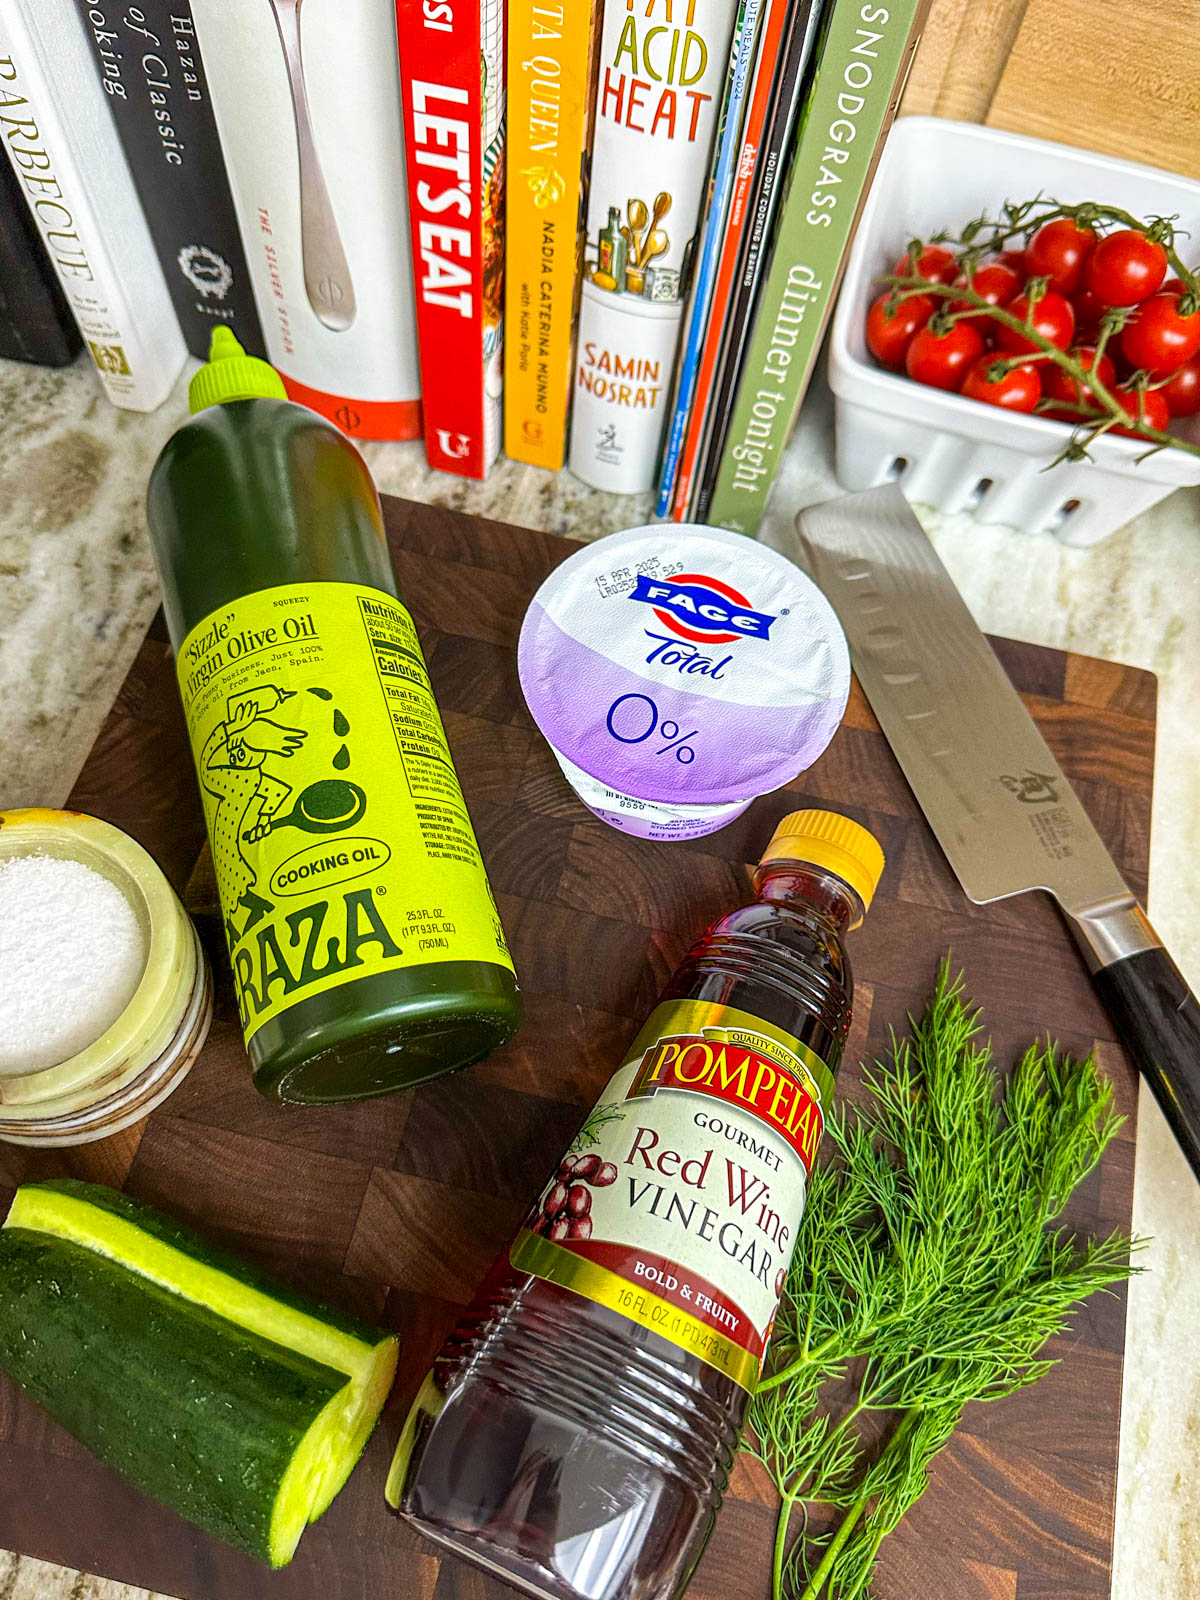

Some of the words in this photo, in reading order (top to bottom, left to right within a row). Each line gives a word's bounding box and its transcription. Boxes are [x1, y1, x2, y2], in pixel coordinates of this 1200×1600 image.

[123, 6, 160, 47] of
[422, 0, 453, 33] SI
[86, 0, 127, 100] oking
[169, 14, 203, 101] Hazan
[613, 15, 708, 87] ACID
[141, 53, 184, 165] Classic
[522, 55, 561, 158] QUEEN
[601, 66, 713, 142] HEAT
[733, 75, 744, 100] 2024
[806, 4, 890, 228] SNODGRASS
[411, 79, 472, 219] LET'S
[739, 143, 757, 179] delish
[762, 152, 777, 196] HOLIDAY
[258, 207, 273, 236] THE
[752, 198, 769, 242] COOKING
[419, 219, 473, 319] EAT
[541, 221, 556, 274] NADIA
[743, 252, 758, 287] BAKING
[264, 244, 284, 299] SILVER
[520, 283, 531, 307] with
[278, 306, 294, 356] SPOON
[519, 310, 531, 340] Katie
[538, 280, 553, 357] CATERINA
[763, 264, 823, 384] dinner
[585, 341, 660, 382] SAMIN
[535, 362, 549, 415] MUNNO
[578, 365, 662, 409] NOSRAT
[732, 390, 786, 493] tonight
[594, 575, 608, 589] 15
[634, 556, 661, 574] 2025
[272, 596, 310, 607] SQUEEZY
[361, 599, 409, 630] Nutrition
[646, 586, 762, 631] FAGE
[187, 652, 225, 697] Virgin
[227, 626, 279, 660] Olive
[283, 613, 319, 639] Oil
[222, 660, 265, 684] business.
[270, 650, 294, 662] Just
[299, 644, 324, 655] 100%
[229, 675, 249, 691] from
[289, 656, 325, 667] Spain.
[377, 656, 424, 684] Calories
[644, 627, 734, 680] Total
[385, 687, 408, 699] Total
[408, 691, 421, 704] Fat
[392, 713, 423, 728] Sodium
[396, 726, 416, 737] Total
[606, 693, 699, 764] 0%
[400, 740, 431, 754] Protein
[619, 800, 646, 811] 9550
[276, 852, 350, 889] COOKING
[351, 846, 381, 863] OIL
[406, 910, 422, 921] 25.3
[409, 924, 420, 936] PT
[420, 923, 432, 935] 9.3
[418, 938, 435, 951] (750
[732, 1032, 770, 1050] QUALITY
[771, 1045, 792, 1065] SINCE
[792, 1062, 808, 1081] 1906
[646, 1043, 824, 1173] POMPEIAN
[693, 1112, 784, 1173] GOURMET
[623, 1126, 714, 1190] Red
[724, 1157, 790, 1254] Wine
[627, 1176, 773, 1290] VINEGAR
[633, 1260, 679, 1292] BOLD
[680, 1284, 693, 1301] &
[694, 1291, 740, 1333] FRUITY
[618, 1288, 632, 1307] 16
[632, 1295, 649, 1318] FL.
[651, 1304, 669, 1328] OZ.
[670, 1315, 681, 1333] (1
[701, 1335, 718, 1357] 473
